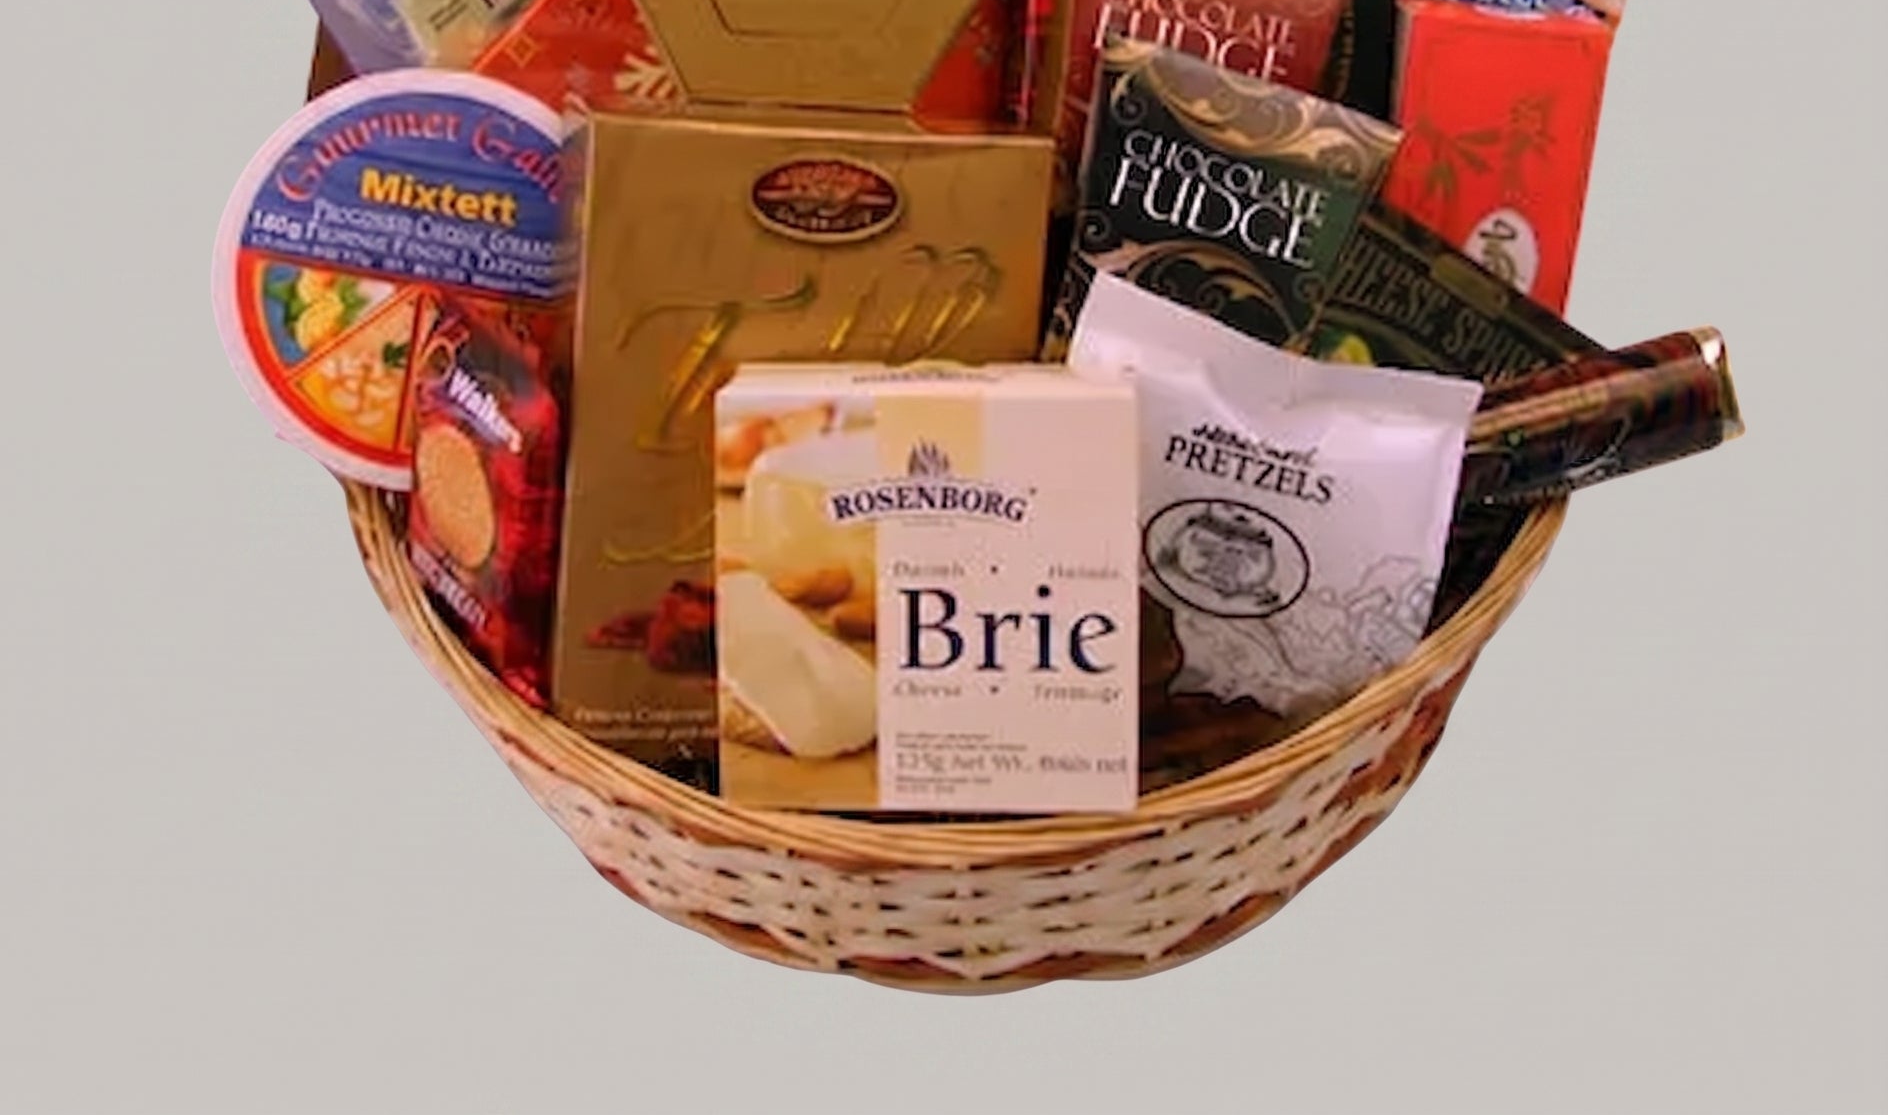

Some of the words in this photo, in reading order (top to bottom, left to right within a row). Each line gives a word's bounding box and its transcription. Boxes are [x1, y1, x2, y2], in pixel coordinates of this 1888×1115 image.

[359, 168, 517, 227] Mixtett
[1109, 157, 1314, 269] FUDGE
[1123, 129, 1330, 228] CHOCOLATE
[1328, 233, 1450, 337] HEESE
[448, 368, 521, 453] Walkers
[831, 485, 1028, 522] ROSENBORG
[1165, 435, 1334, 505] PRETZELS
[898, 584, 1118, 675] Brie
